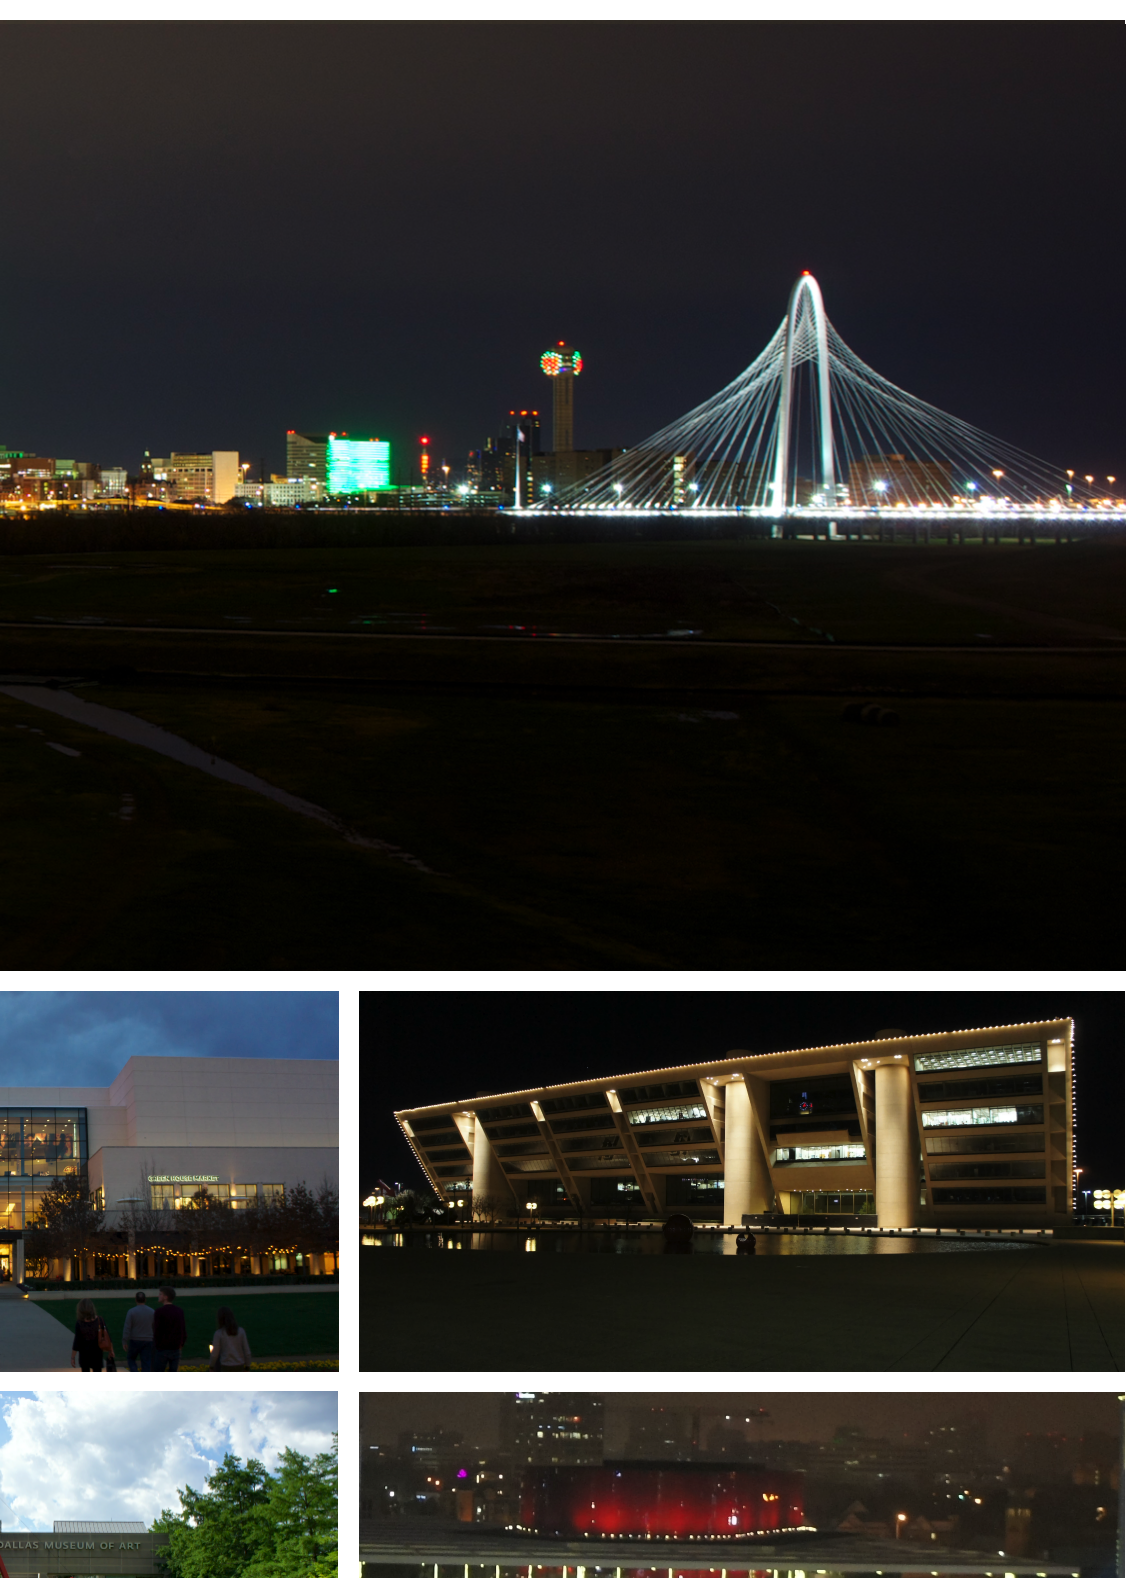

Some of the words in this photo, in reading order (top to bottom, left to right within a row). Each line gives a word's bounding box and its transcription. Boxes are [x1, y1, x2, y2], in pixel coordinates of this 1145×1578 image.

[44, 1541, 95, 1550] MUSEUM
[100, 1541, 114, 1550] OF
[119, 1541, 141, 1550] ART
